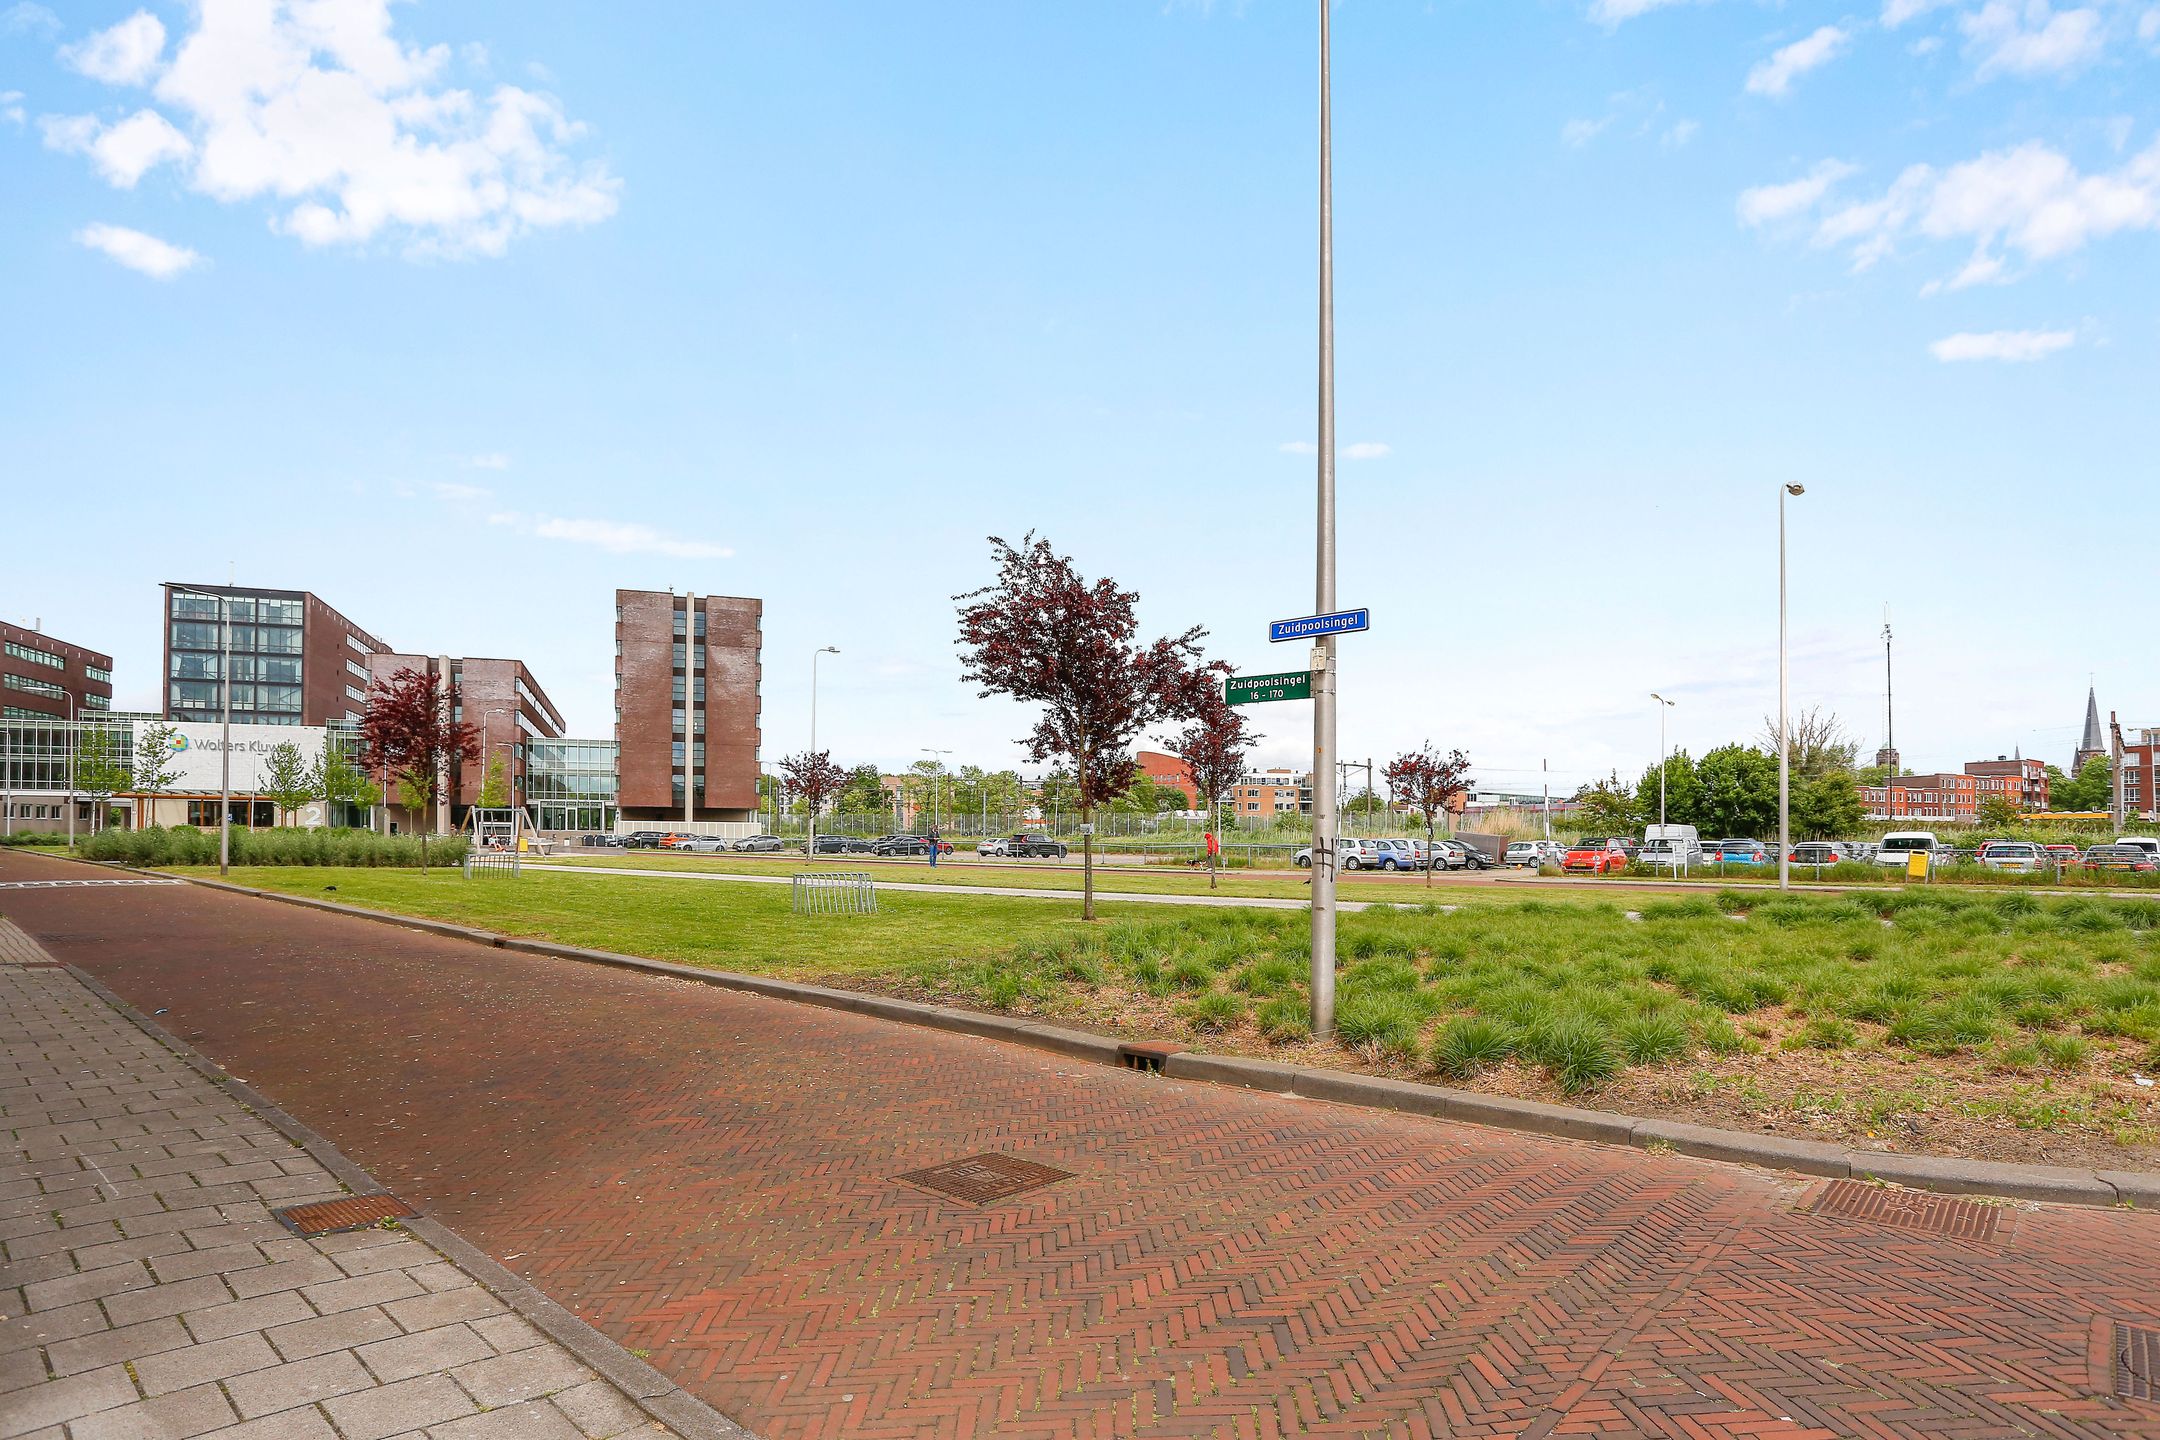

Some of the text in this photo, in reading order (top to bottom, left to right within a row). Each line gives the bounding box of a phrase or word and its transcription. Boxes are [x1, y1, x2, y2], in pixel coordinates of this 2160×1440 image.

[1278, 614, 1358, 634] Zuidpoolsingel
[1230, 674, 1306, 690] Zuidpoolsingel
[1250, 691, 1259, 700] 16
[1269, 689, 1284, 699] 170
[304, 806, 322, 825] 2
